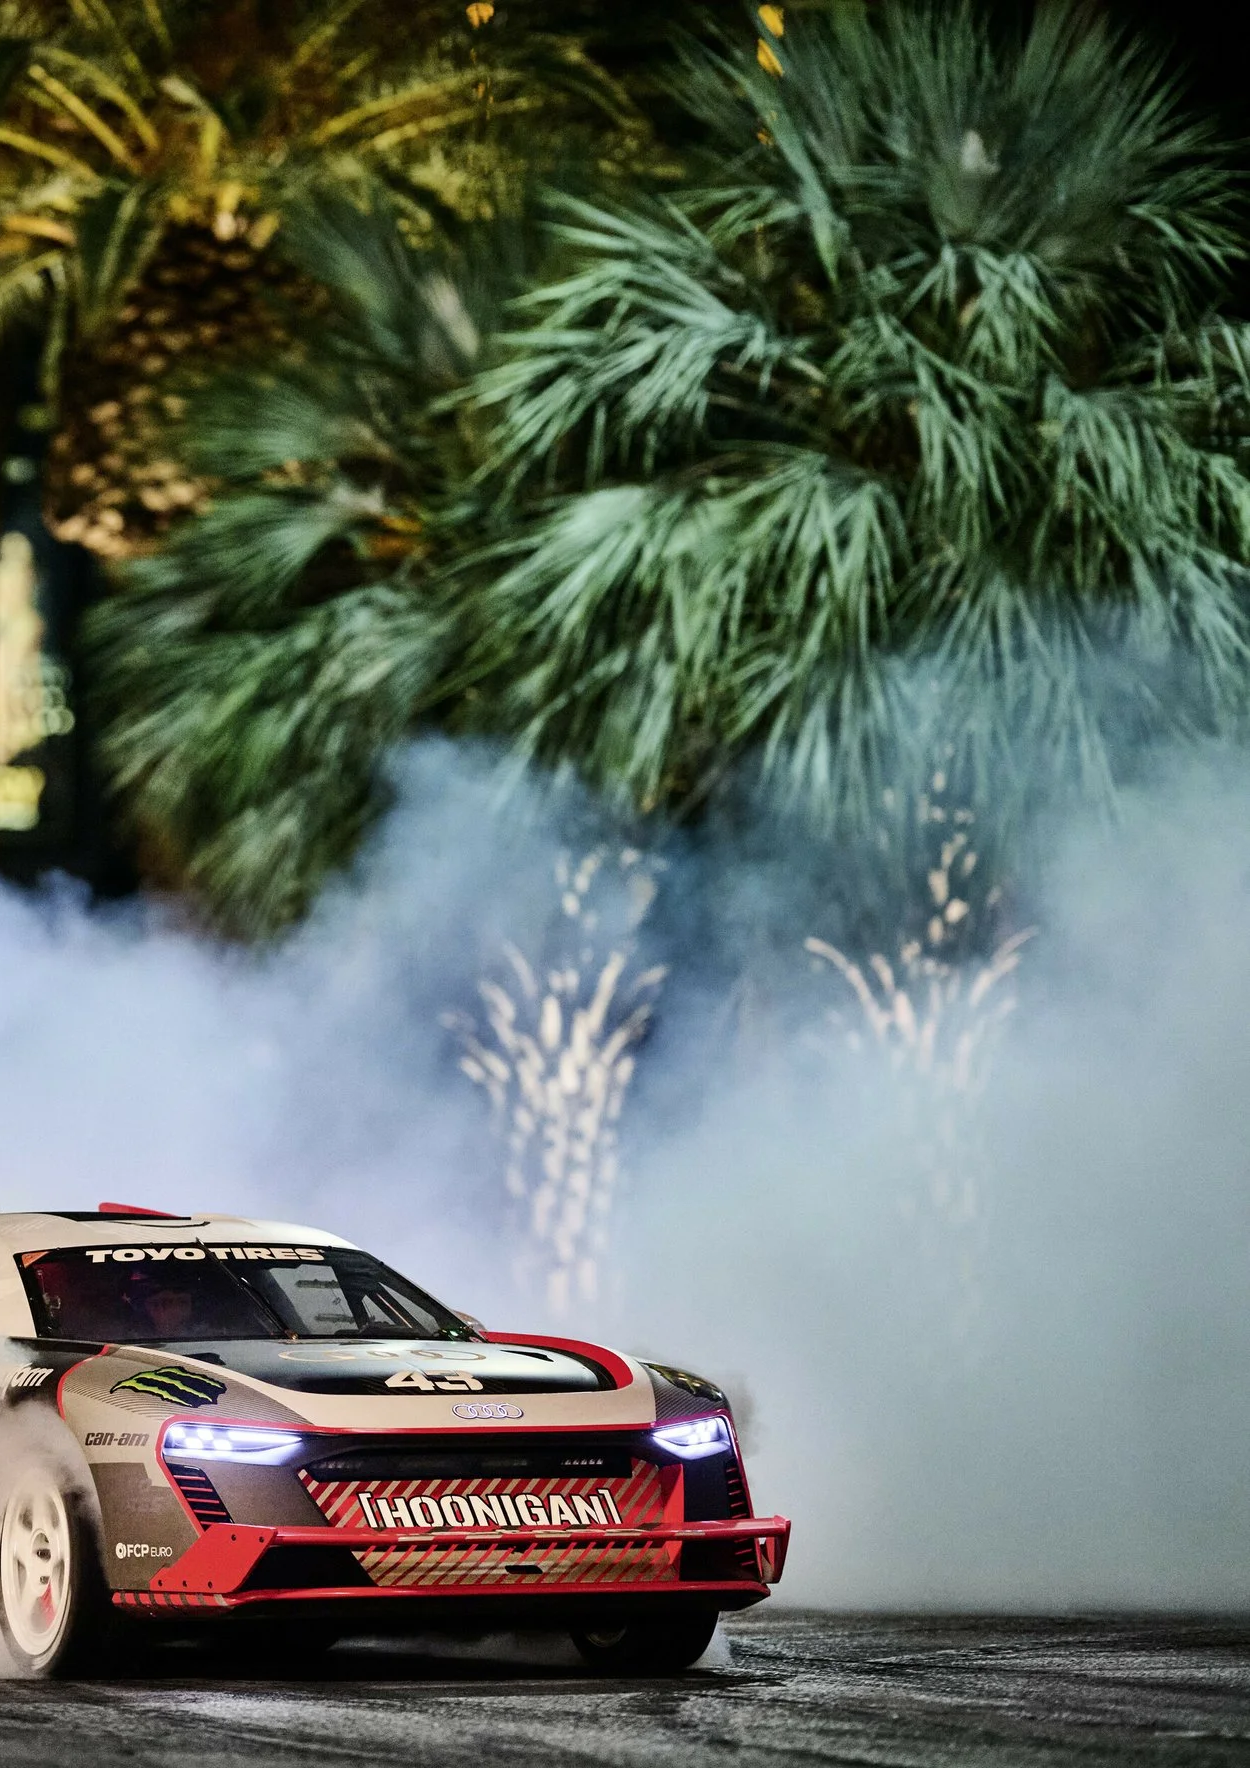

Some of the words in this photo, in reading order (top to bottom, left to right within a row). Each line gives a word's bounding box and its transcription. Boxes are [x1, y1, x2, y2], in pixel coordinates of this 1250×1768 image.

[85, 1246, 206, 1264] TOYO
[207, 1246, 324, 1262] TIRES
[384, 1369, 484, 1391] 43
[84, 1432, 150, 1447] can-am
[126, 1543, 150, 1558] FCP
[150, 1546, 173, 1558] EURO
